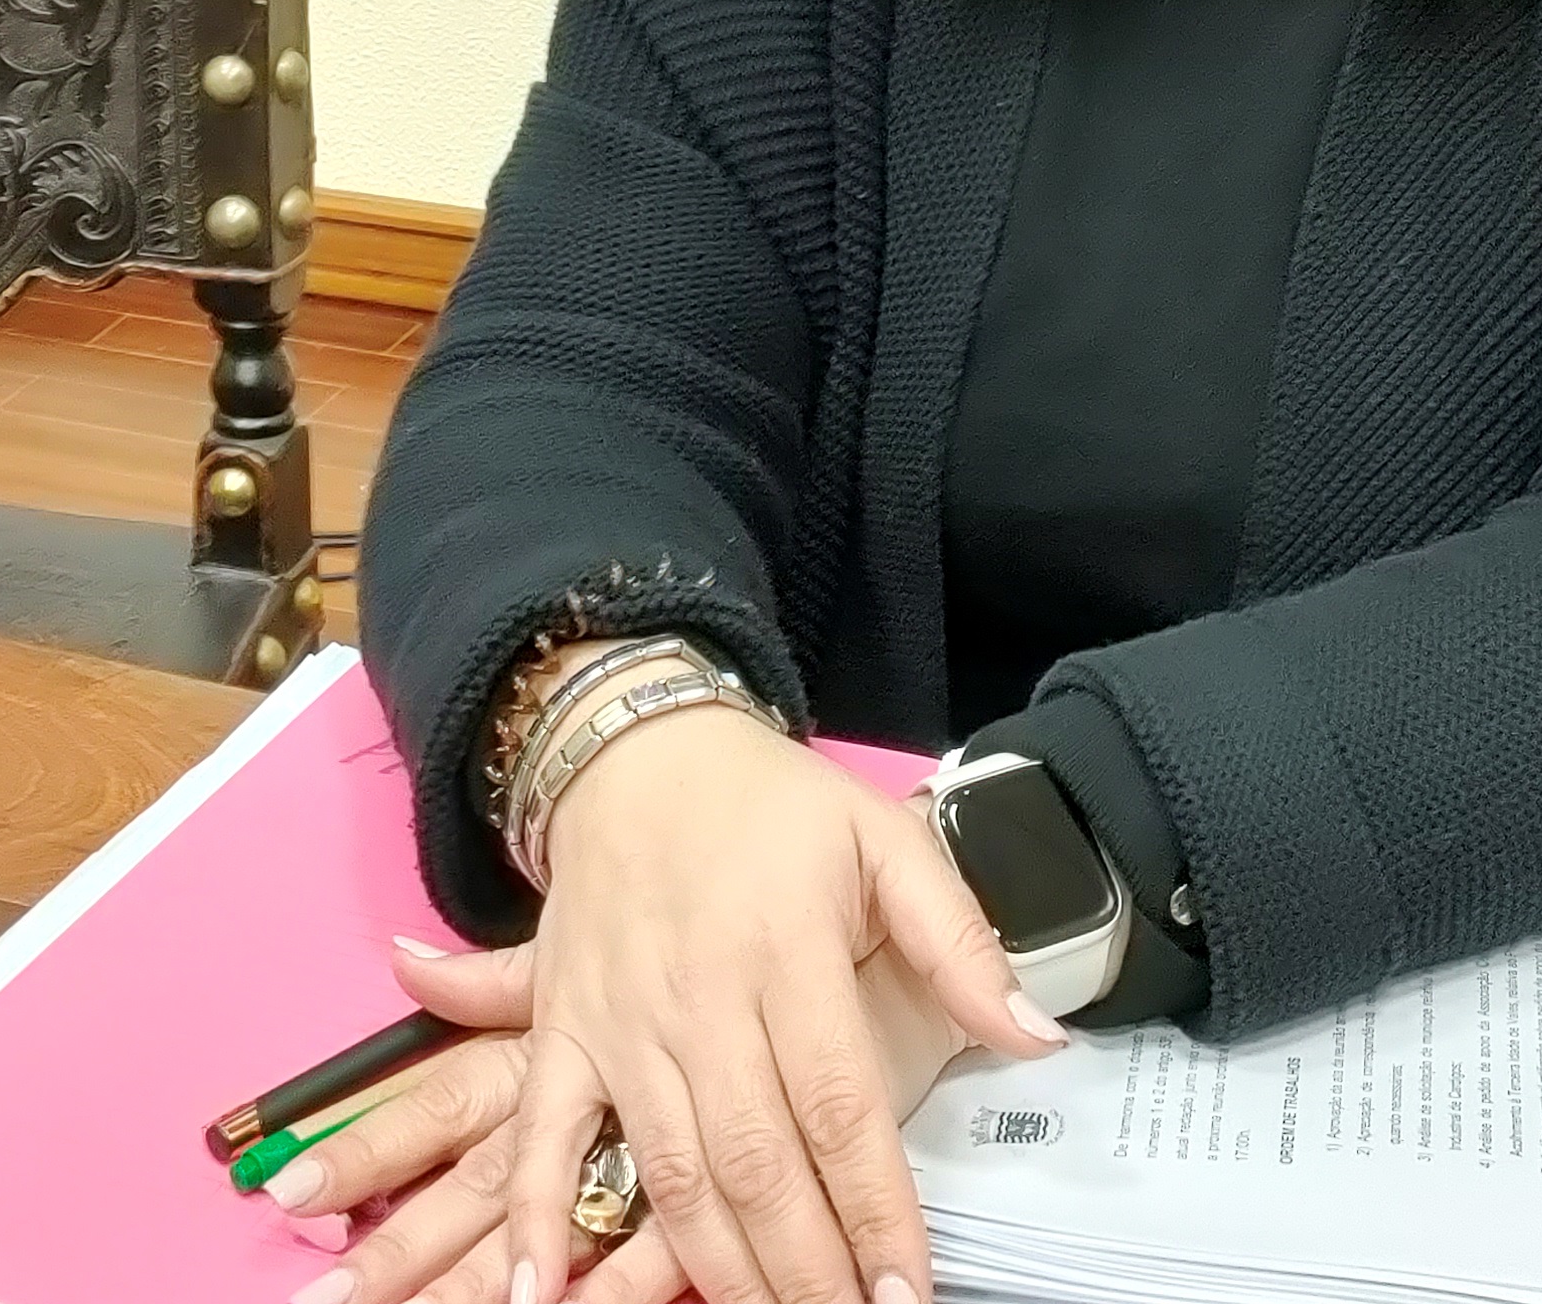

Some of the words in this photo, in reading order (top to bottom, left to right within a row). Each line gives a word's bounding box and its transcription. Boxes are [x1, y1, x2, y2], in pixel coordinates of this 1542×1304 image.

[1283, 1057, 1301, 1110] TRABALHOS
[1282, 1112, 1297, 1125] DE
[1279, 1128, 1296, 1164] ORDEM
